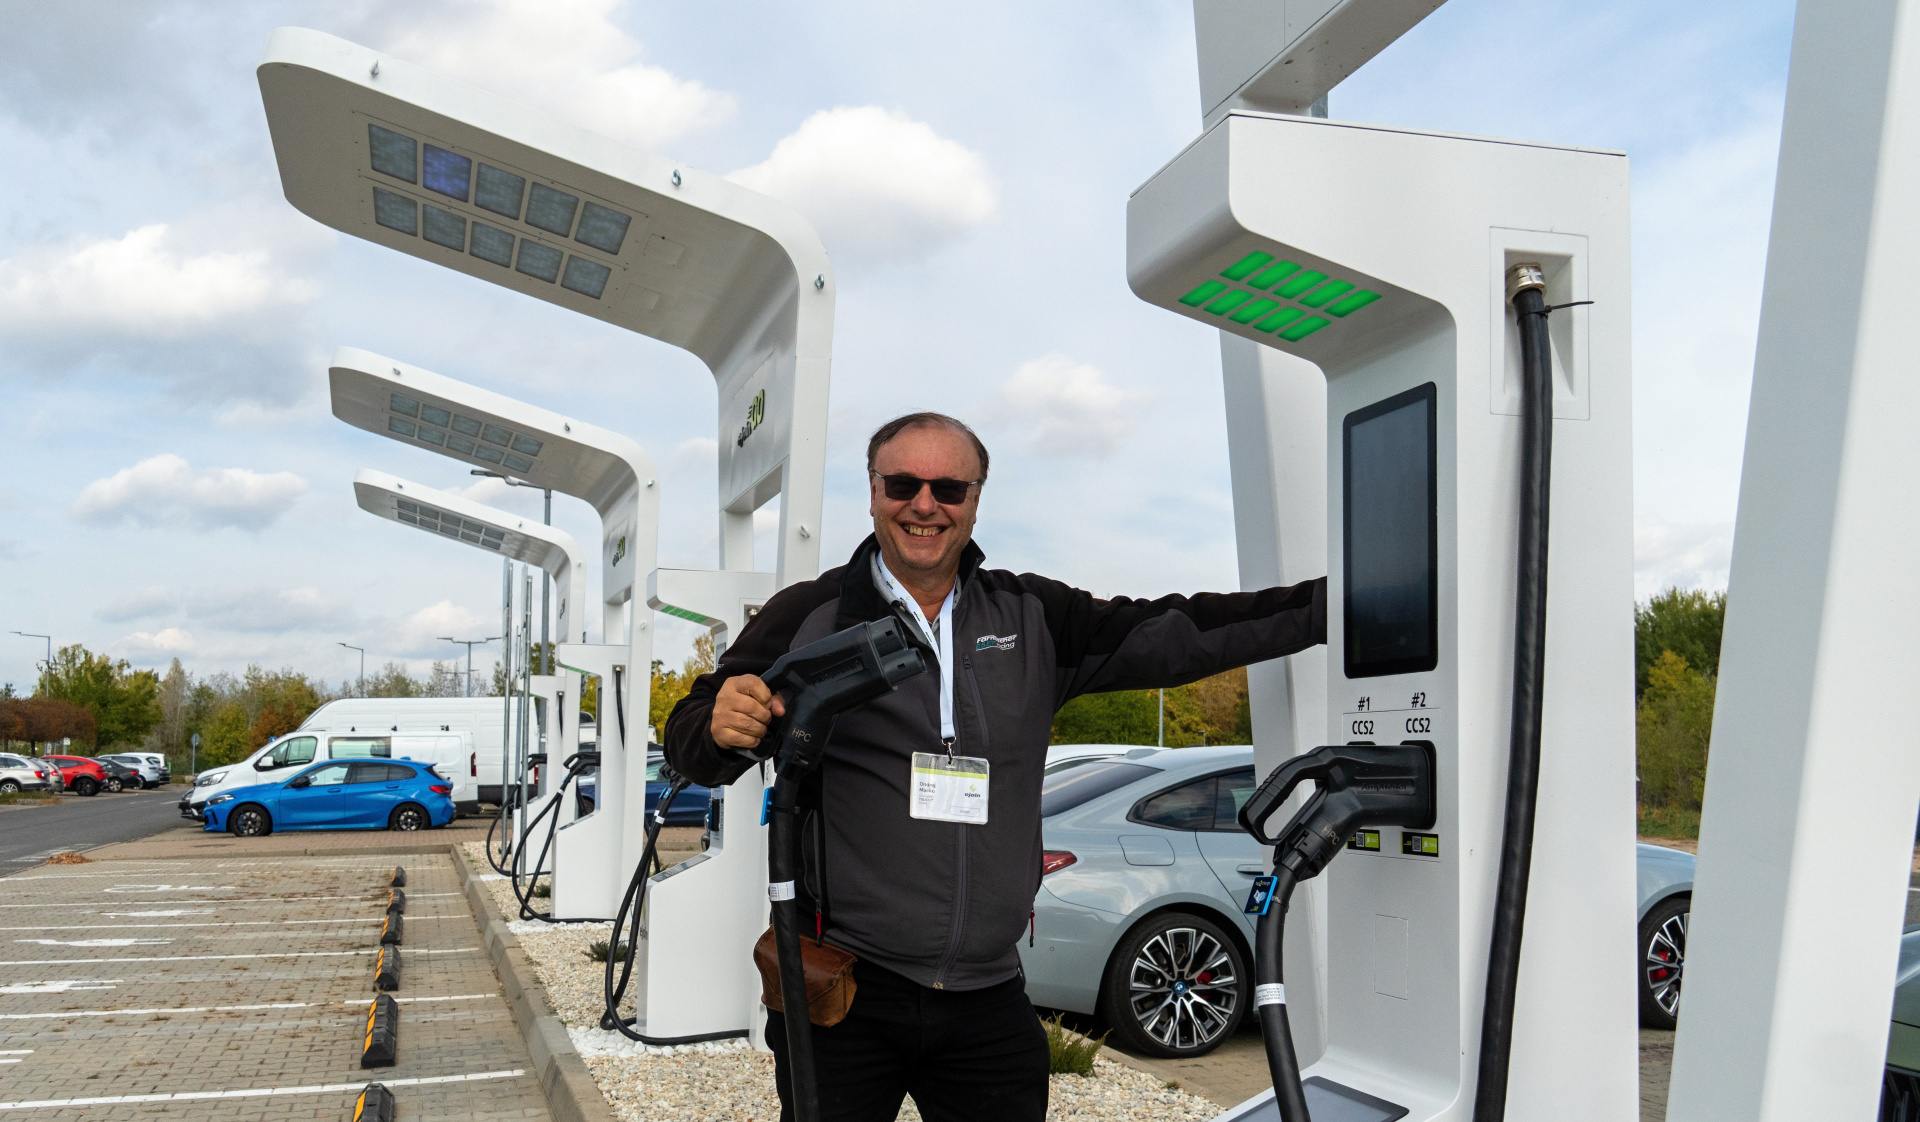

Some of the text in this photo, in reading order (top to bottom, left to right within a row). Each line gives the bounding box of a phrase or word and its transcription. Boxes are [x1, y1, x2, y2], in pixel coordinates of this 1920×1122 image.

[1357, 696, 1370, 711] #1
[1411, 692, 1426, 707] #2
[1352, 720, 1374, 735] CCS2
[1405, 717, 1431, 733] CCS2
[792, 728, 812, 742] HPC
[1322, 825, 1340, 845] HPC
